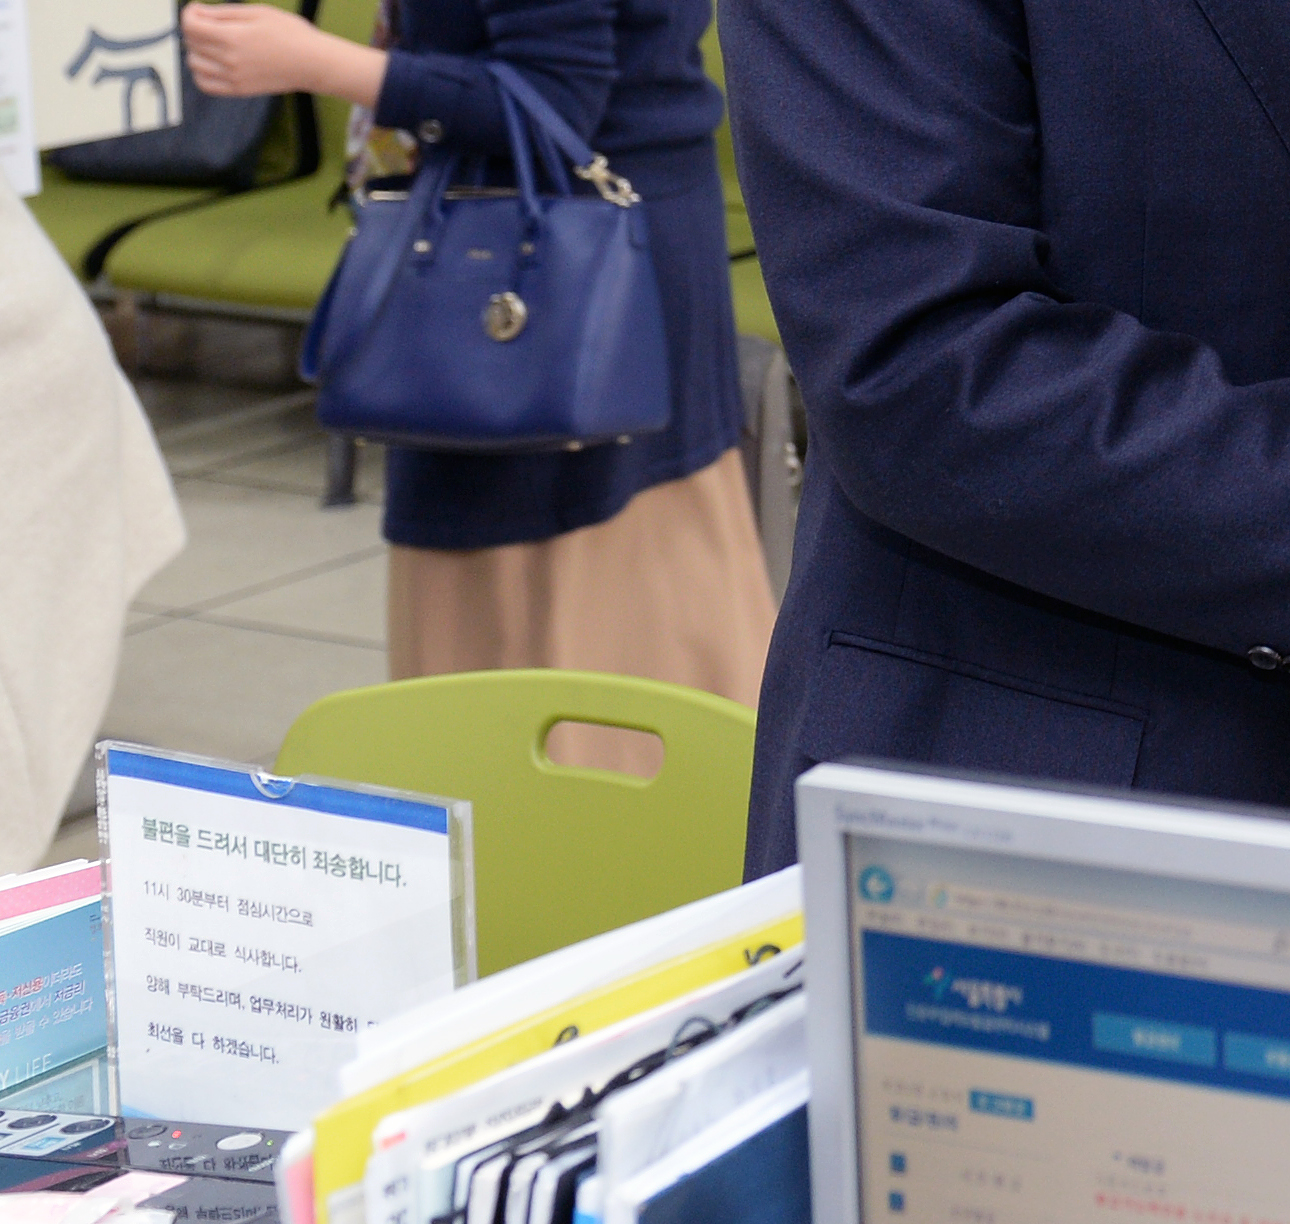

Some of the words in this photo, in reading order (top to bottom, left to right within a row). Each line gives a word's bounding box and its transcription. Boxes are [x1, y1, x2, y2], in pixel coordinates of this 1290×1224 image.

[142, 817, 191, 848] 불편을
[197, 829, 248, 860] 드려서
[254, 840, 306, 869] 대단히
[312, 850, 407, 888] 죄송합니다.
[144, 880, 169, 900] 11시
[176, 887, 229, 913] 30분부터
[237, 898, 313, 927] 점심시간으로
[145, 927, 180, 951] 직원이
[188, 936, 227, 958] 교대로
[234, 945, 302, 974] 식사합니다.
[53, 979, 86, 1003] 저금리
[146, 974, 170, 996] 양해
[177, 982, 245, 1010] 부탁드리며,
[249, 994, 313, 1025] 업무처리가
[319, 1010, 358, 1033] 원활히
[147, 1021, 184, 1046] 최선을
[191, 1032, 205, 1050] 다
[212, 1035, 280, 1065] 하겠습니다.
